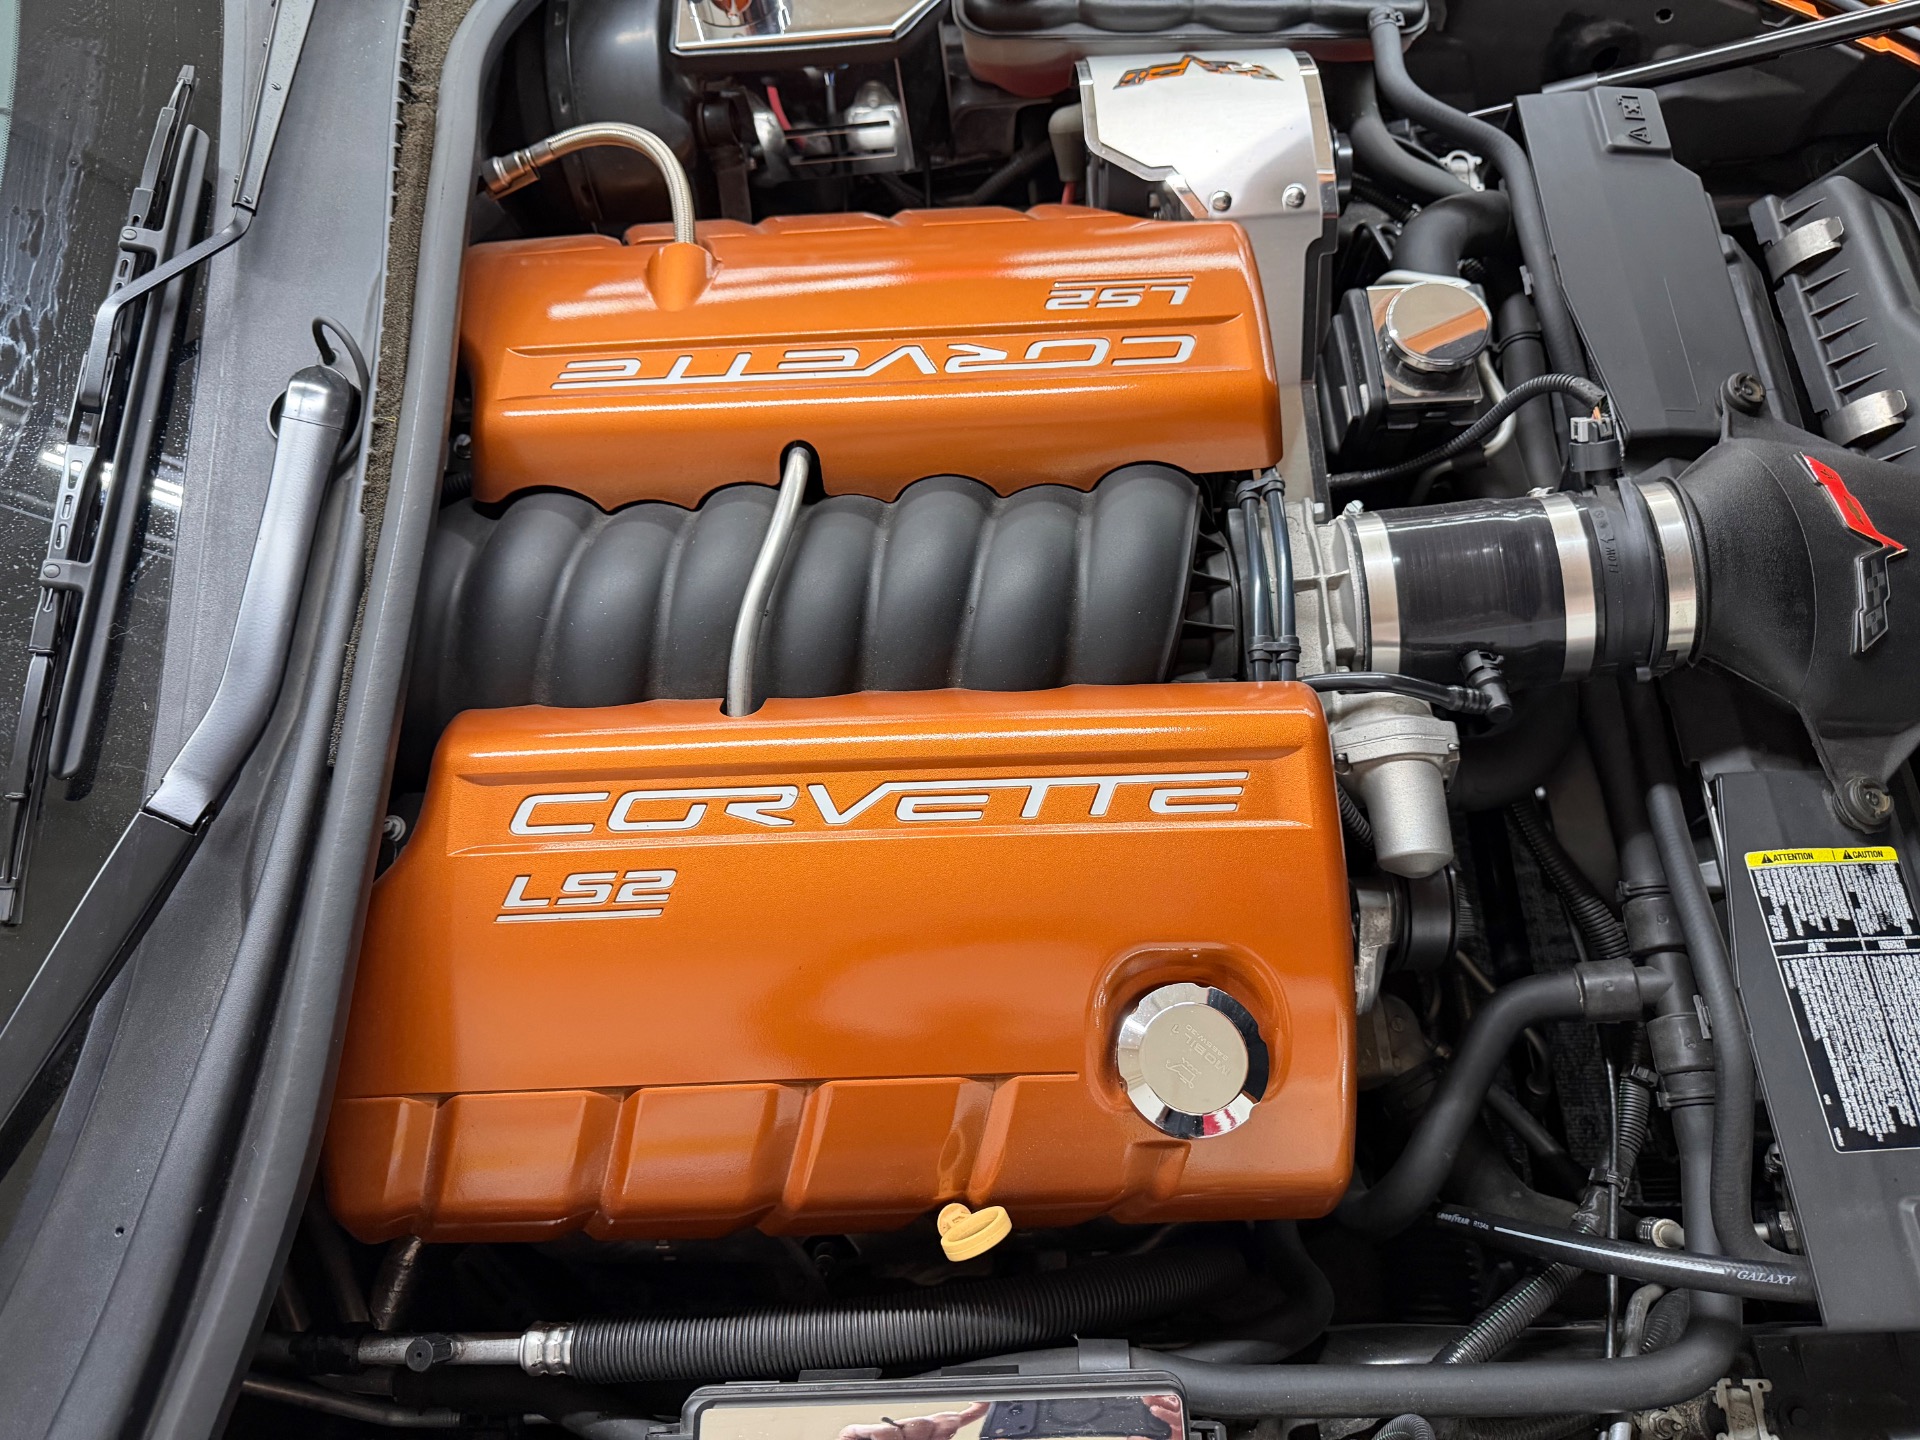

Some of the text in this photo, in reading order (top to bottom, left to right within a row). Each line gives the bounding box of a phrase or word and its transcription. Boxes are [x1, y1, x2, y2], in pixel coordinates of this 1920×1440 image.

[1045, 284, 1190, 310] LS2
[550, 334, 1196, 390] CORVETTE
[509, 771, 1249, 836] CORVETTE
[1773, 852, 1814, 862] ATTENTION
[1852, 850, 1884, 859] CAUTION
[502, 868, 678, 909] LS2
[1171, 1024, 1231, 1076] MOBIL 1
[1736, 1270, 1797, 1285] GALAXY
